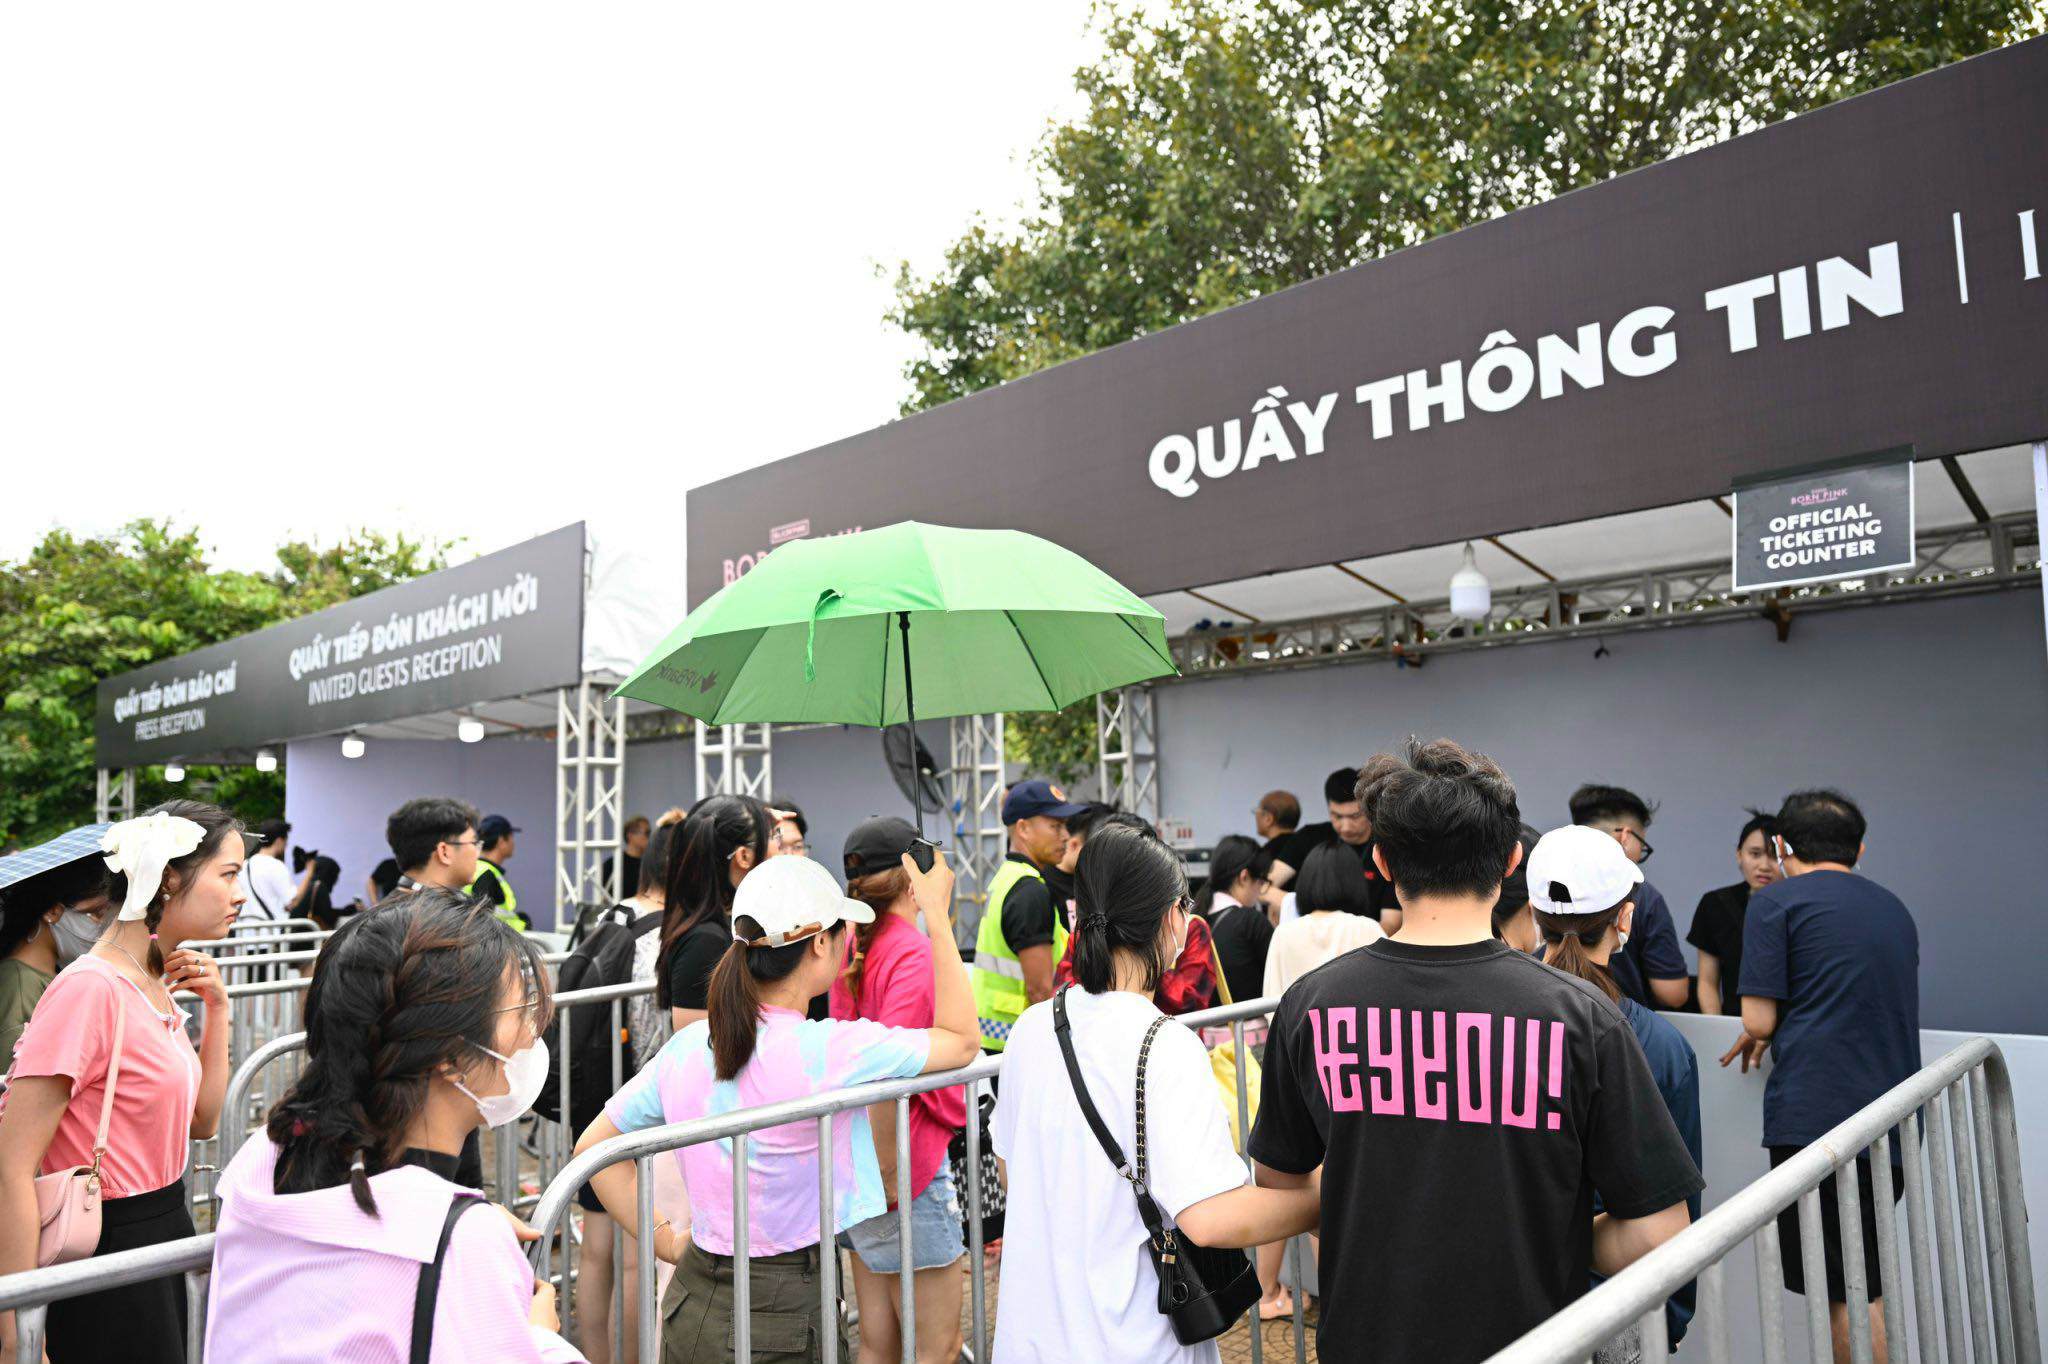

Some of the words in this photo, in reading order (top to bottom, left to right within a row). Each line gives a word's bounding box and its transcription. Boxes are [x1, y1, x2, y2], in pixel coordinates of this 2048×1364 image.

[1148, 385, 1339, 498] QUẦY
[1356, 330, 1677, 440] THÔNG
[1705, 242, 1904, 353] TIN
[1768, 503, 1873, 533] OFFICIAL
[1759, 519, 1882, 553] TICKETING
[1766, 539, 1876, 570] COUNTER
[333, 621, 370, 665] TIẾP
[415, 593, 488, 643] KHÁCH
[491, 572, 539, 622] MỜI
[308, 672, 357, 707] INVITED
[358, 657, 411, 695] GUESTS
[411, 634, 502, 683] RECEPTION
[160, 707, 207, 737] RECEPTION
